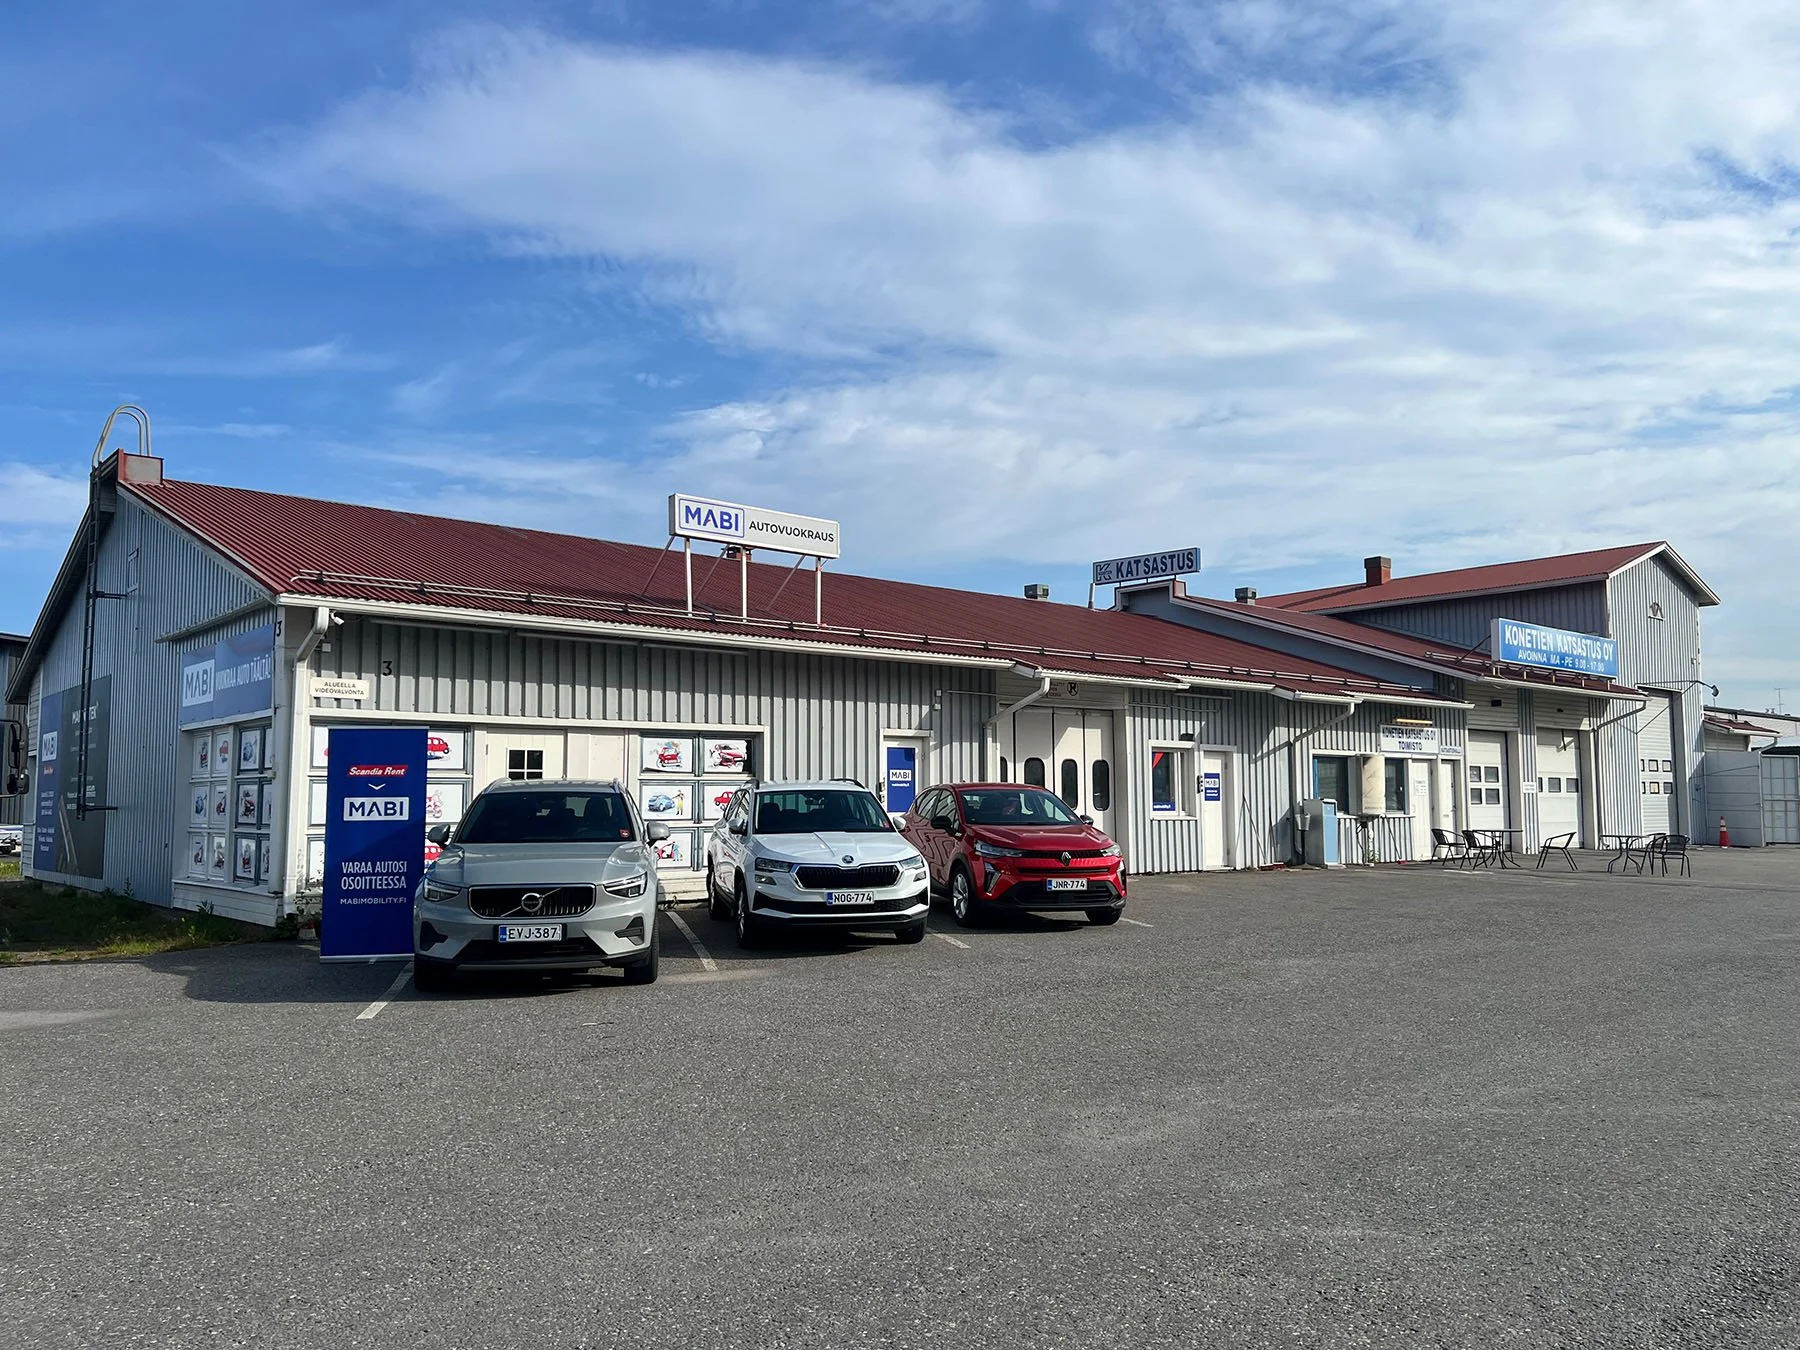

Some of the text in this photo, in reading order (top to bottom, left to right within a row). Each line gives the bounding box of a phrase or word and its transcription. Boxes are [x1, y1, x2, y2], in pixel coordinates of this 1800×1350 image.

[685, 505, 834, 542] MABI AUTOVUOKRAUS
[1116, 552, 1194, 579] KATSASTUS
[277, 620, 283, 637] 3
[1505, 624, 1614, 661] KONETIEN KATSASTUS OY
[1518, 649, 1547, 663] AVOINNA
[382, 660, 393, 676] 3
[185, 667, 213, 699] MABI
[349, 766, 405, 776] Scandia Rent
[891, 771, 910, 779] MABI
[349, 801, 404, 817] MABI
[342, 861, 407, 874] VARAA AUTOSI
[341, 876, 407, 890] OSOITTEESSA
[1053, 880, 1085, 889] JNR-774
[340, 897, 407, 905] MABIMOBILITY.FI
[834, 893, 872, 903] NOG-774
[508, 927, 558, 940] EVJ-387
